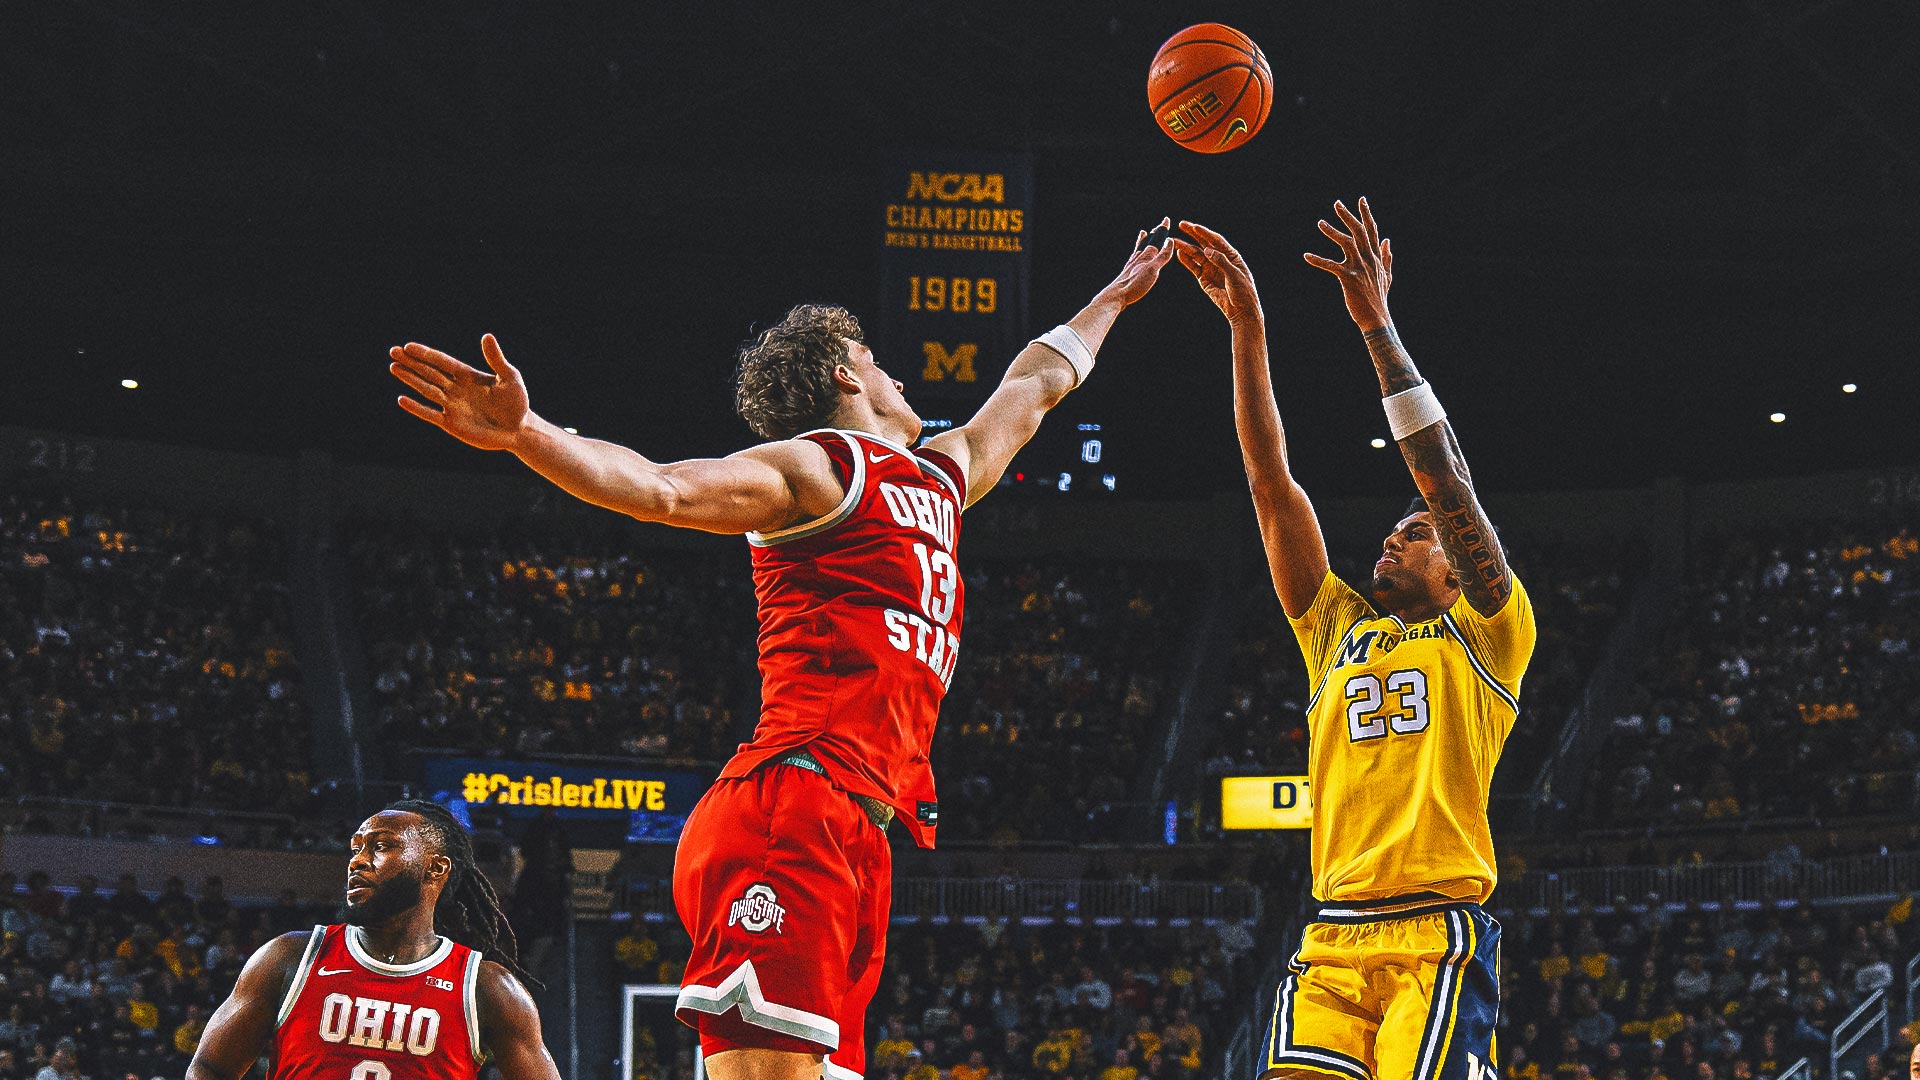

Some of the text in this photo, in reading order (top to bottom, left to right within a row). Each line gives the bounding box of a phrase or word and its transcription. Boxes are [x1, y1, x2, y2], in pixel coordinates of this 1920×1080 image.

[1165, 91, 1223, 135] ELITE
[907, 172, 1004, 203] NCAA
[887, 204, 1023, 232] CHAMPIONS
[933, 234, 1022, 251] BASKETBALL
[909, 276, 997, 312] 1989
[922, 341, 978, 381] M
[27, 439, 97, 473] 212
[879, 482, 954, 554] OHIO
[913, 542, 957, 626] 13
[884, 608, 959, 694] STAT
[1334, 622, 1447, 671] MICIGAN
[1344, 667, 1431, 743] 23
[462, 772, 666, 811] #CrislerLIVE
[318, 992, 441, 1057] OHIO
